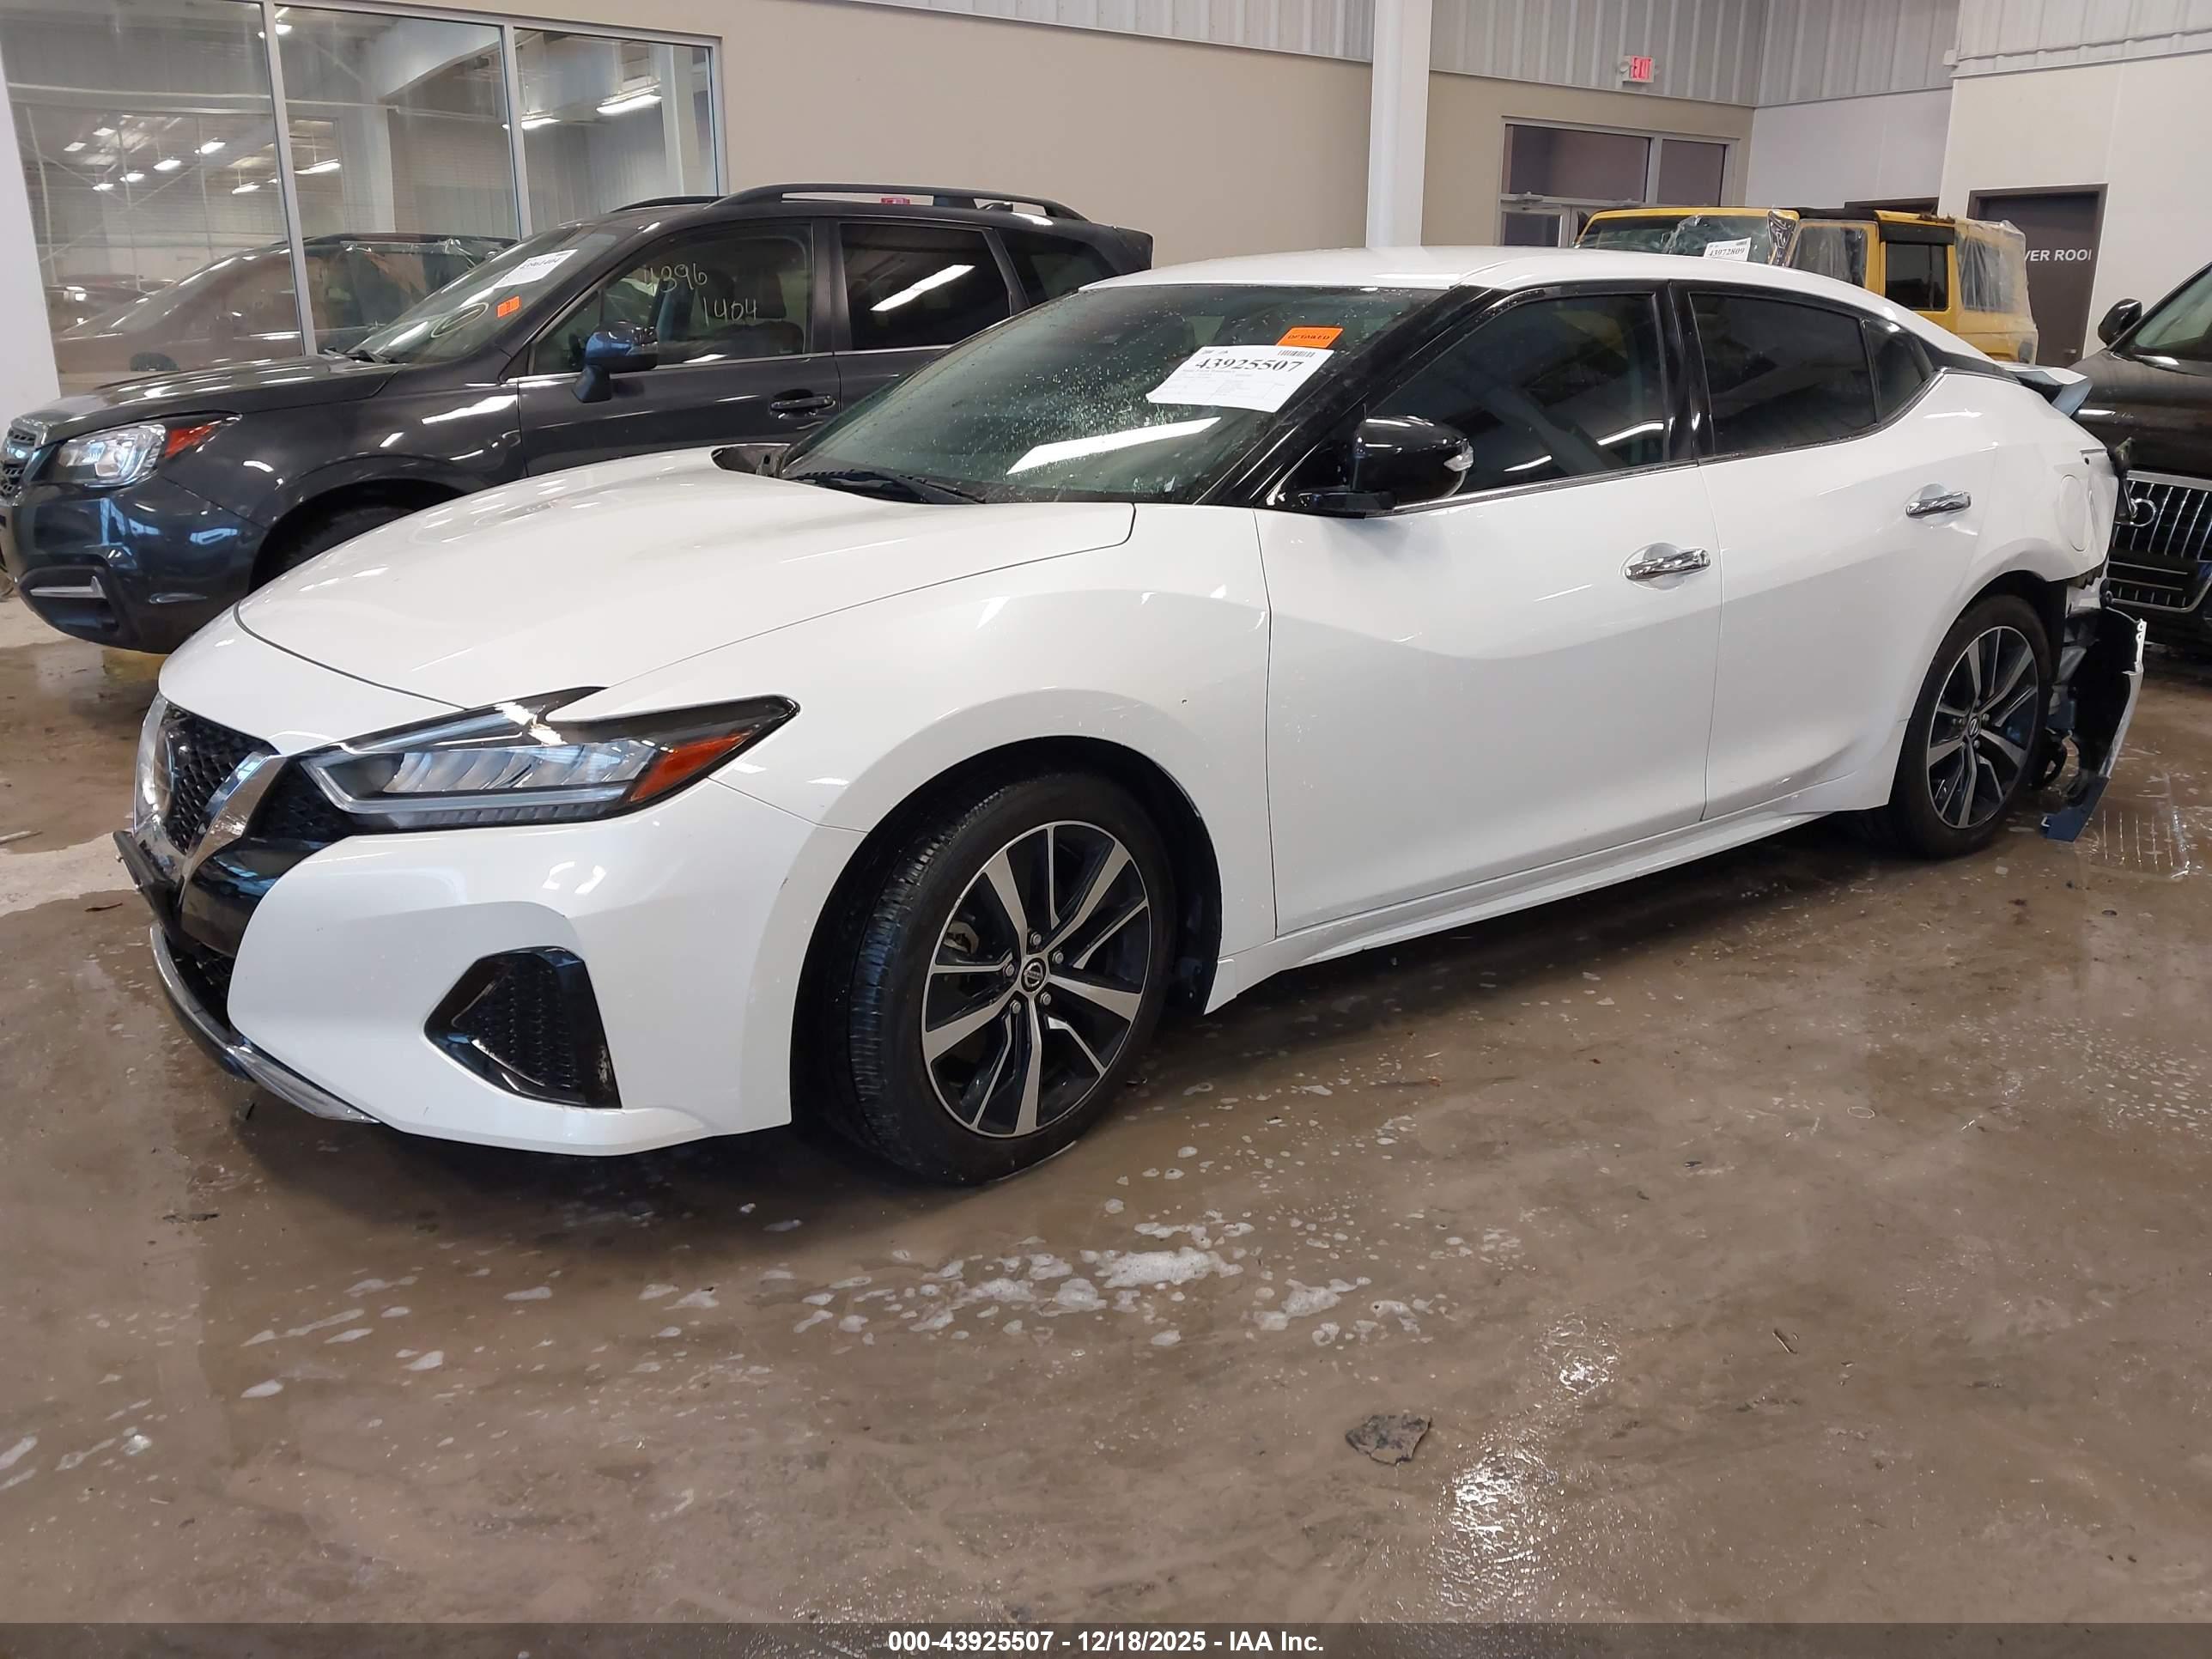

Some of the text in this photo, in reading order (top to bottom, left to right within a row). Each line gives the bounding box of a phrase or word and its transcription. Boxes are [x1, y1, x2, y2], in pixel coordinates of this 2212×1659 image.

[2054, 248, 2092, 262] ROO
[702, 295, 757, 328] 1404
[1194, 357, 1305, 373] 43925507
